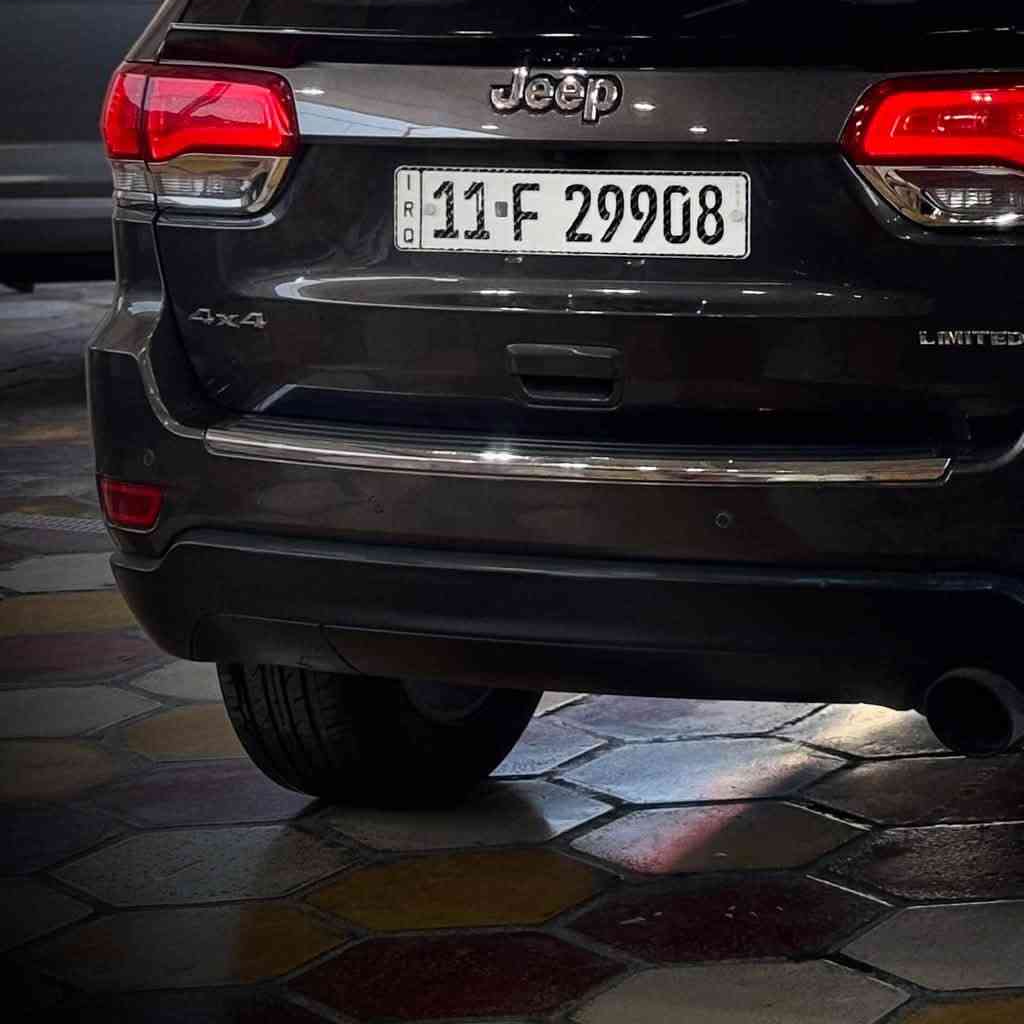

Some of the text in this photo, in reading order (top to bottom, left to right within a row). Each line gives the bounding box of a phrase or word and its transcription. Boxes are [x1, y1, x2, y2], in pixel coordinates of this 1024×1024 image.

[490, 66, 619, 121] Jeep
[433, 180, 725, 245] 11 F 29908
